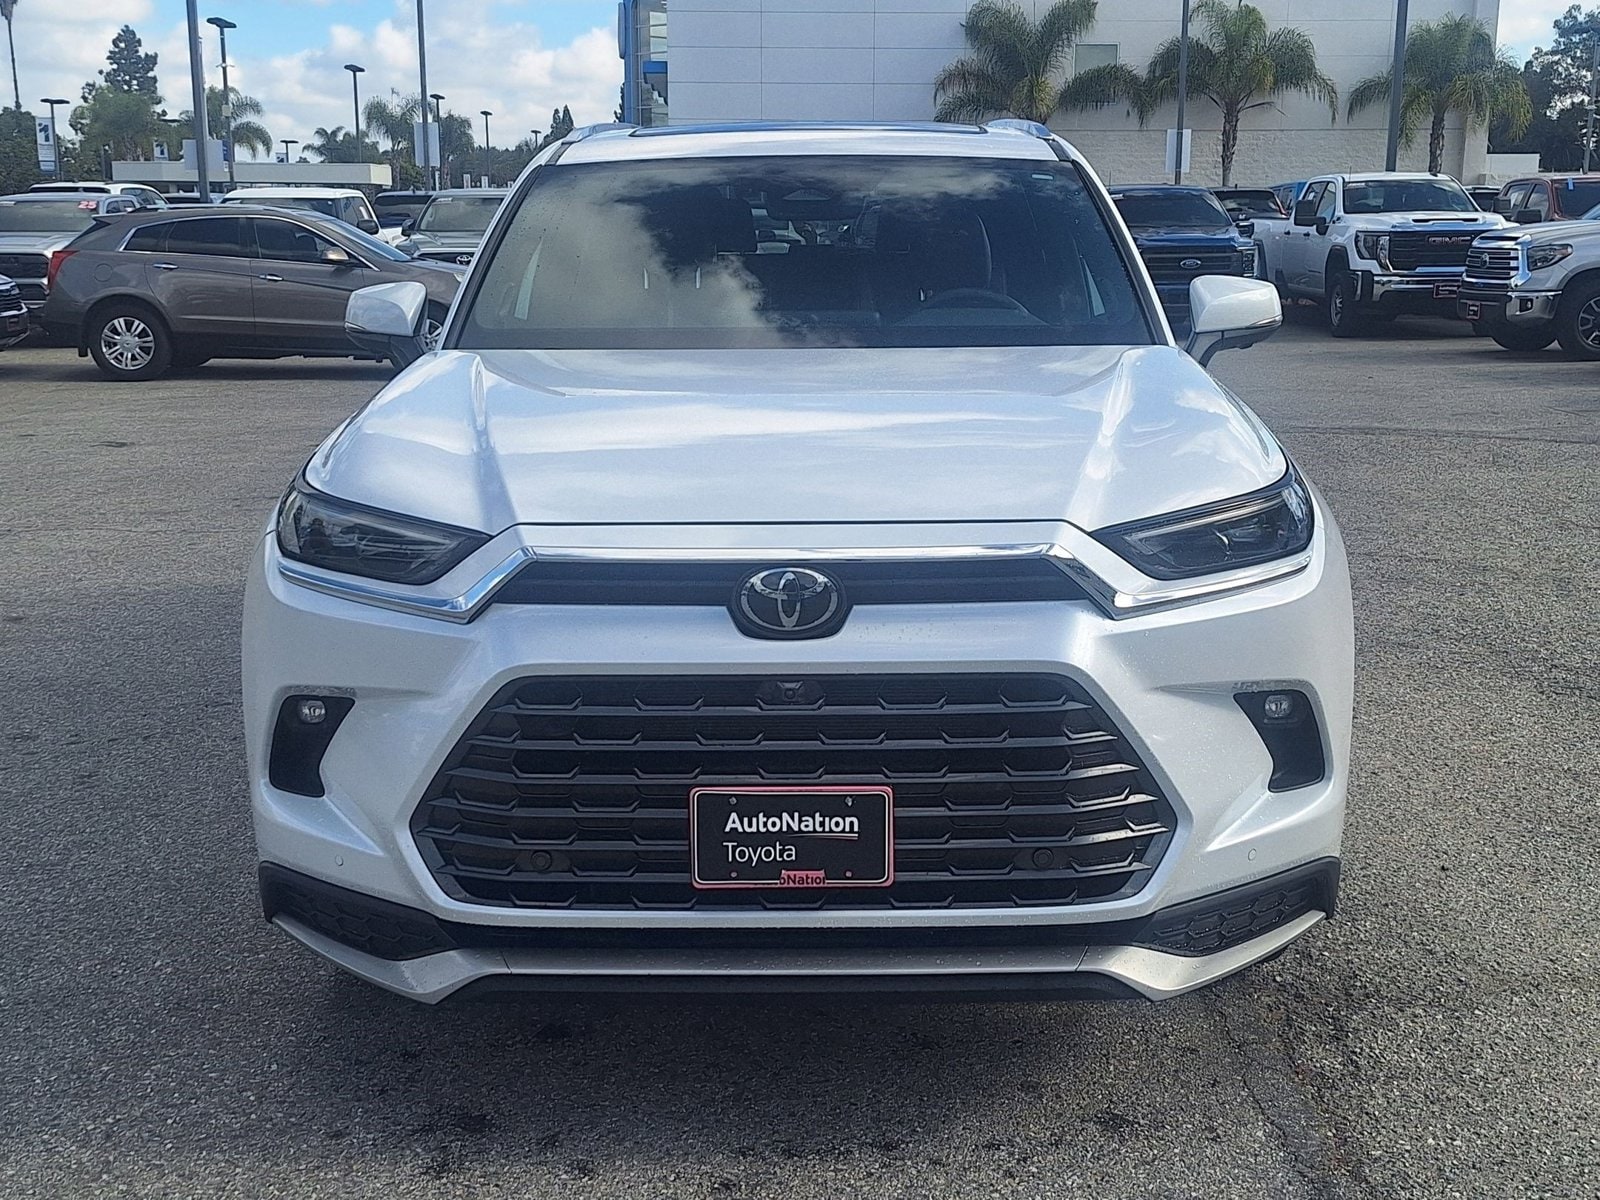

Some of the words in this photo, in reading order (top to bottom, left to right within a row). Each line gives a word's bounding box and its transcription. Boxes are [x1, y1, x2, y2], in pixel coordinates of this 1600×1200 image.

[1428, 236, 1471, 245] GMC
[724, 812, 859, 832] AutoNation
[722, 841, 796, 867] Toyota
